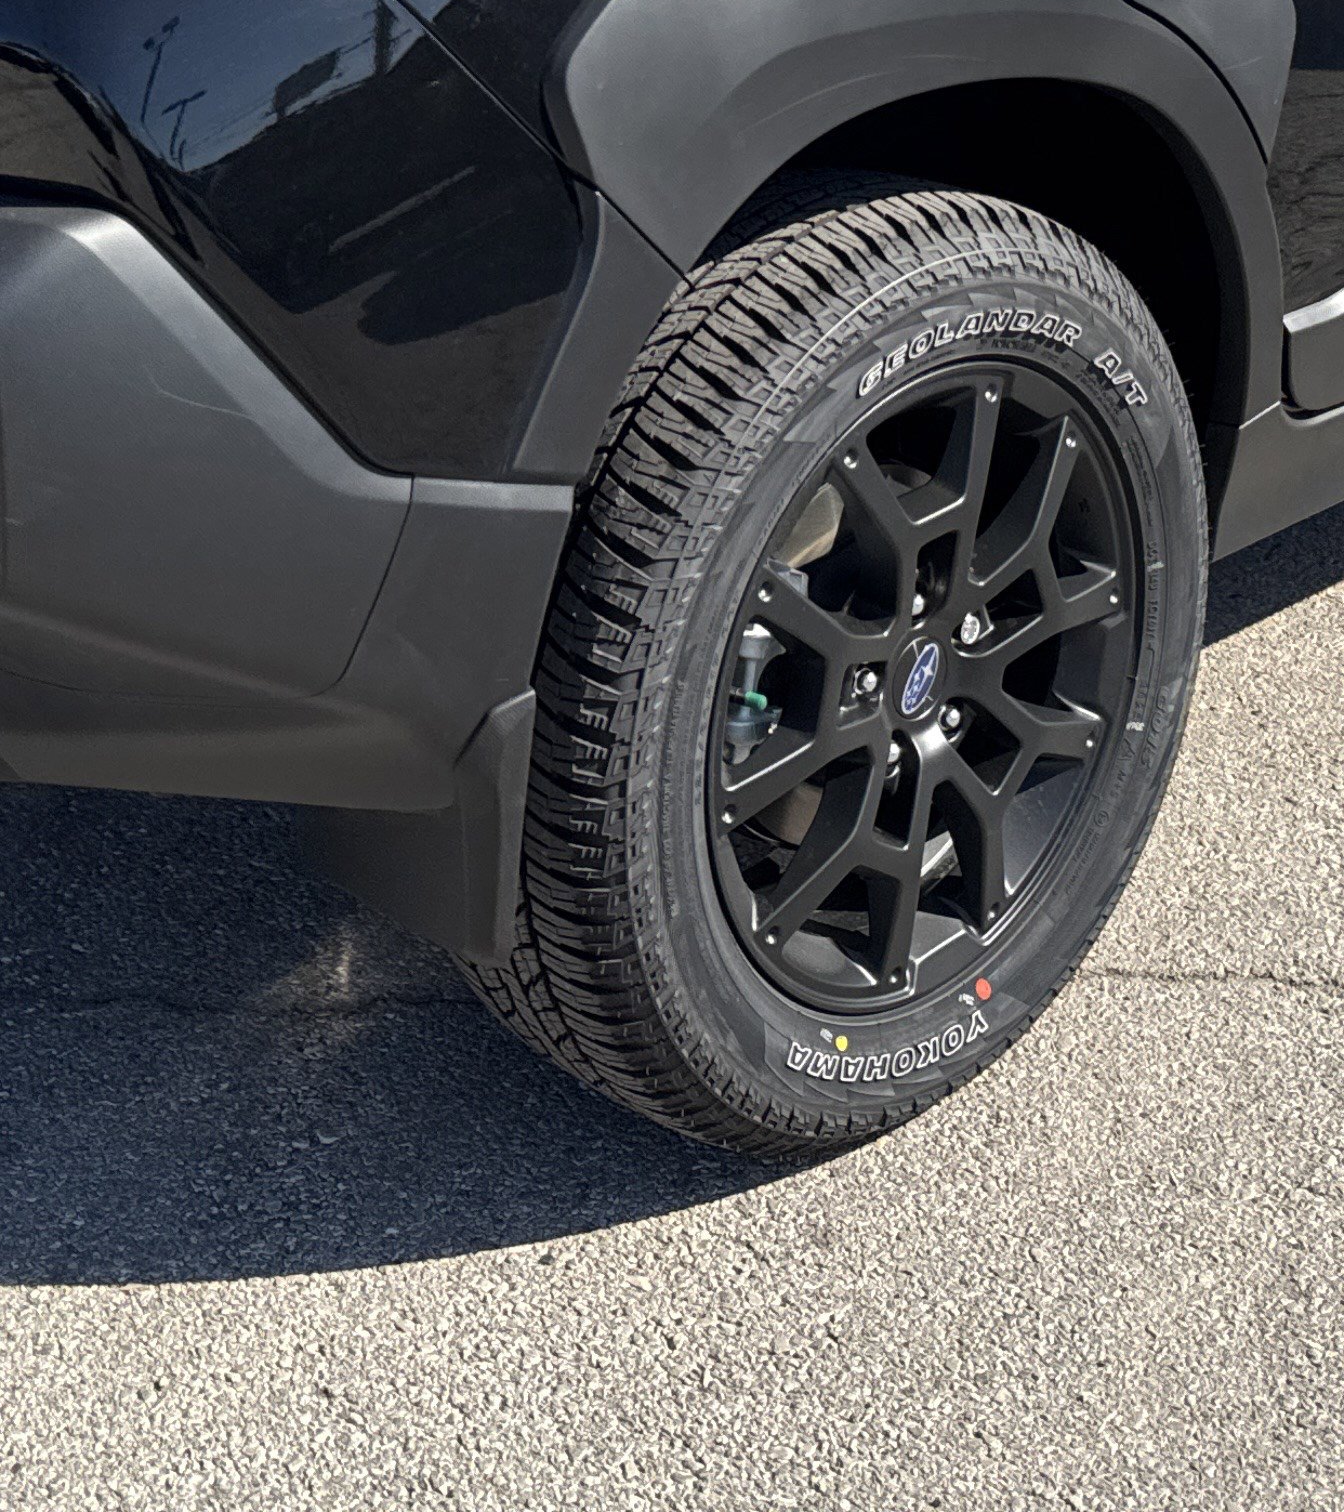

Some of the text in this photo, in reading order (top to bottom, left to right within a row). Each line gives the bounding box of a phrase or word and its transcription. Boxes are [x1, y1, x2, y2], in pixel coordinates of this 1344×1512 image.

[858, 308, 1083, 397] GEOLANDAR
[1093, 348, 1149, 406] A/T
[786, 1009, 989, 1083] YOKOHAMA
